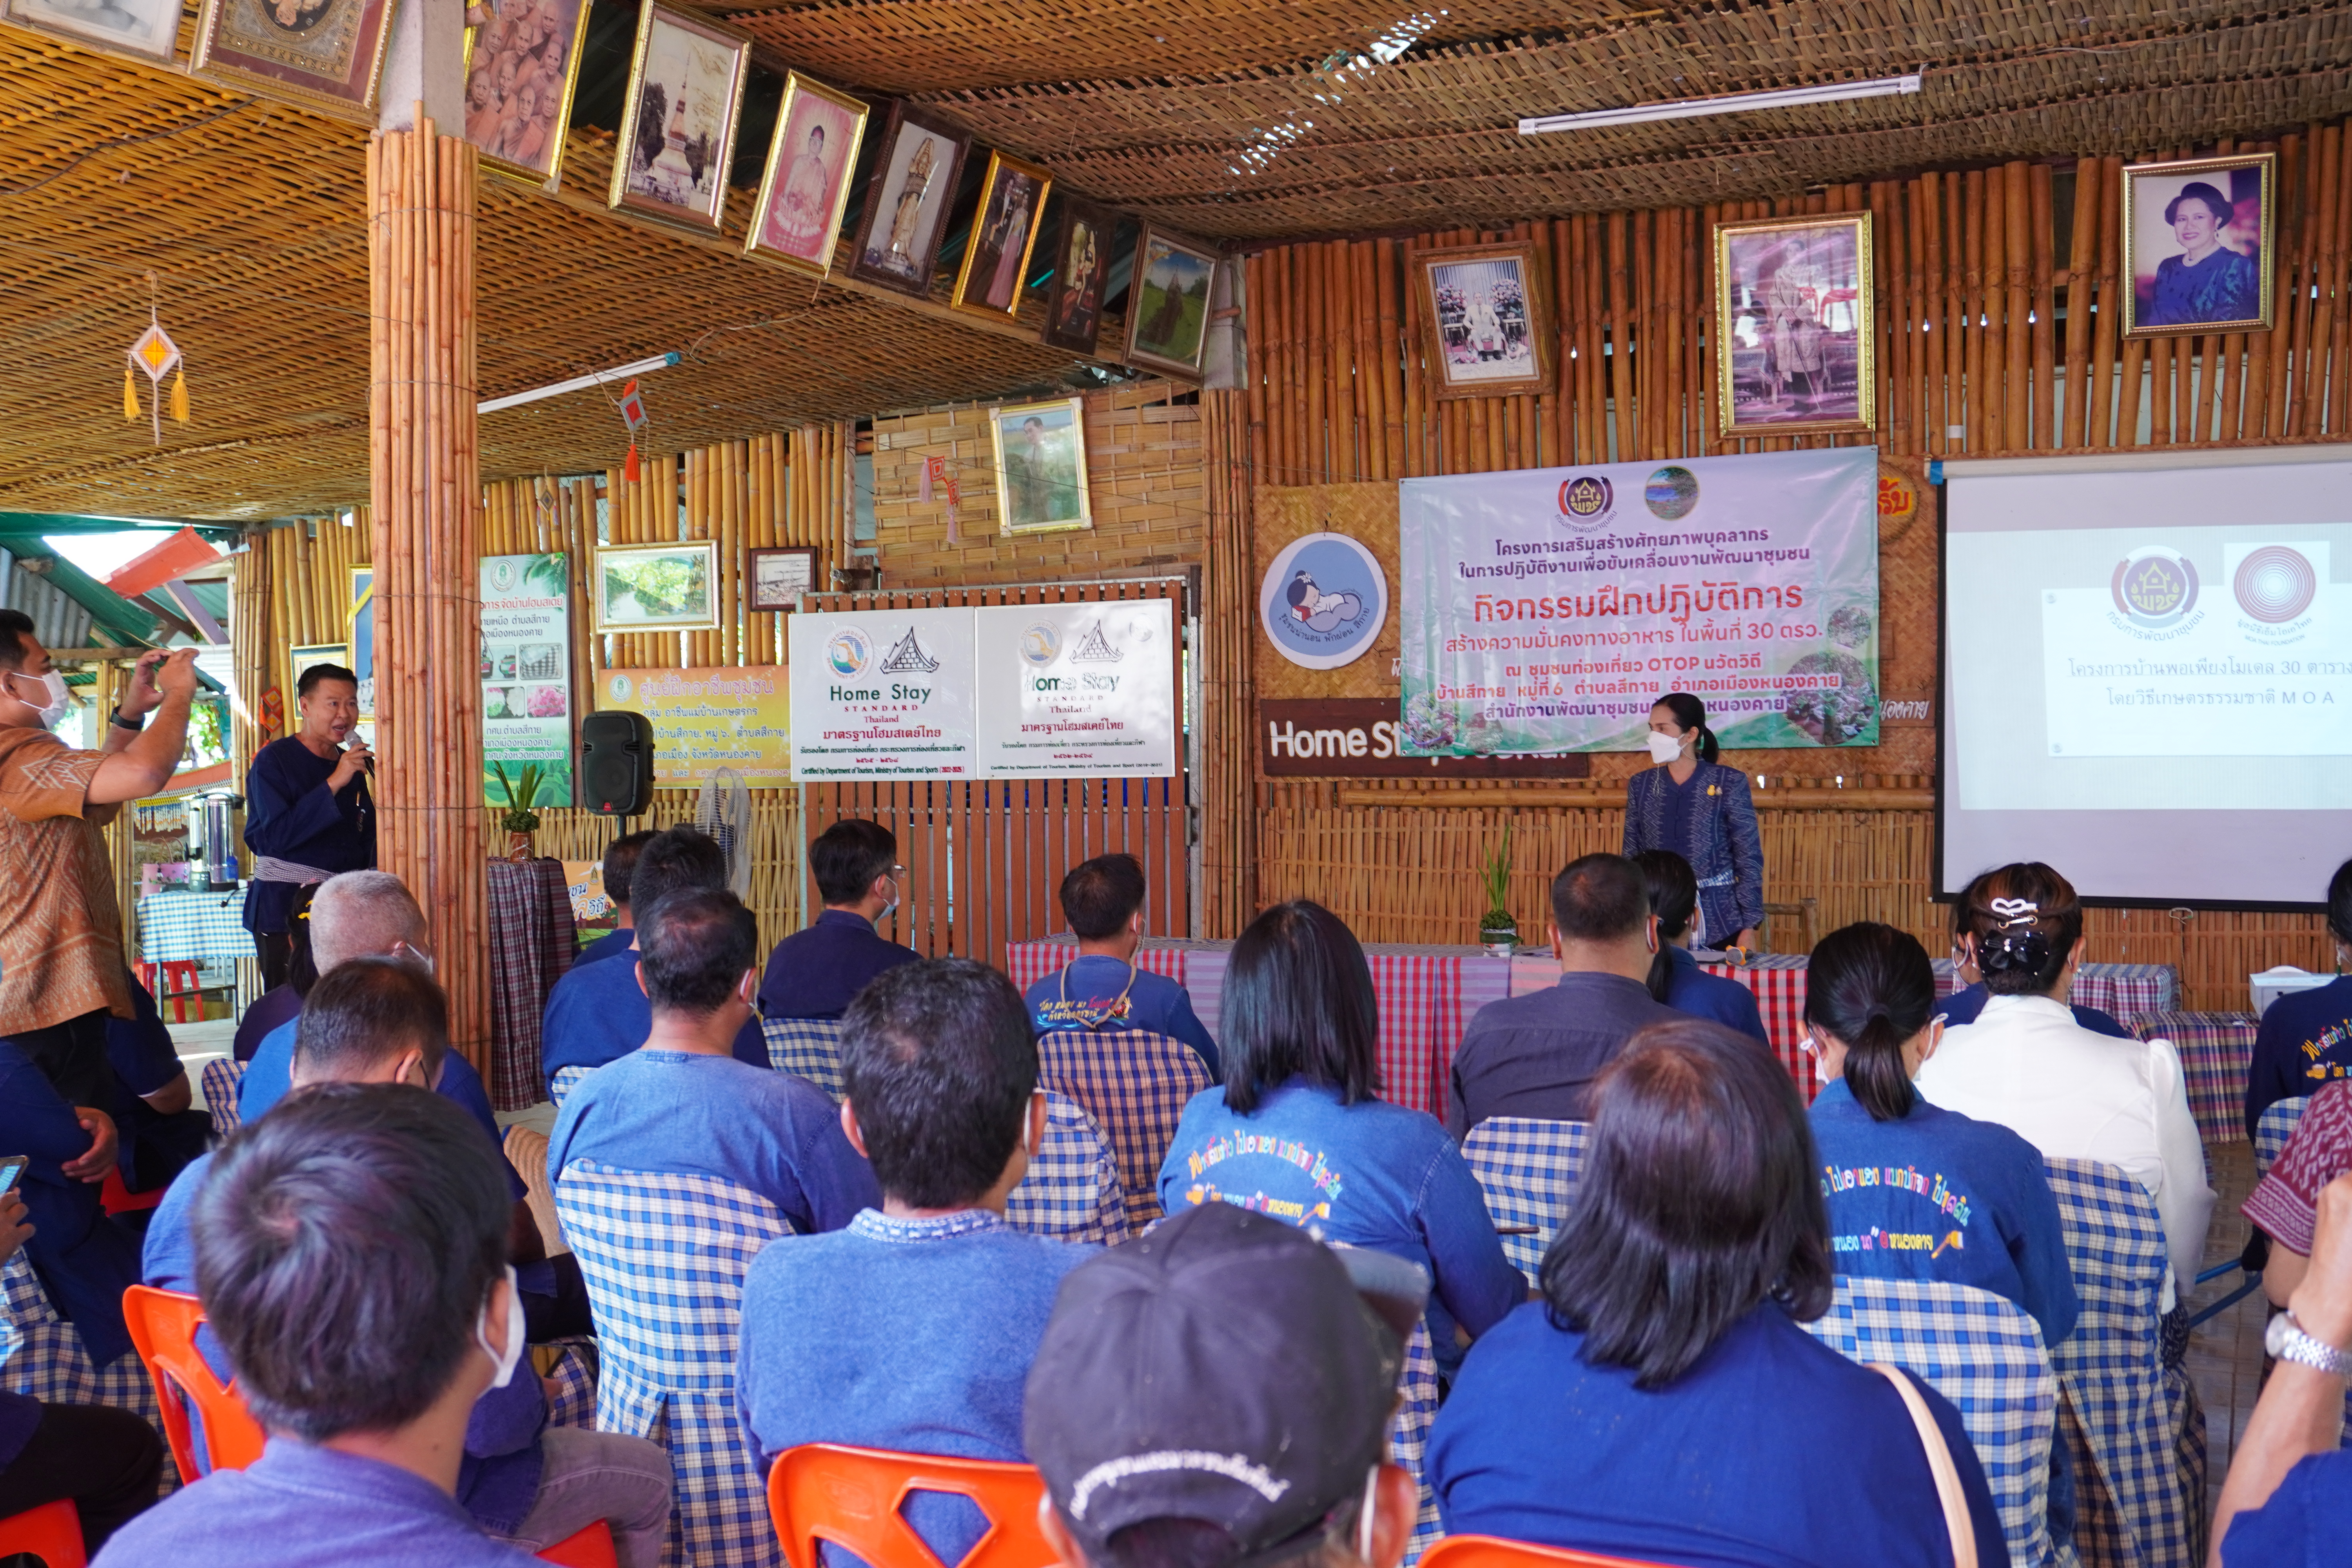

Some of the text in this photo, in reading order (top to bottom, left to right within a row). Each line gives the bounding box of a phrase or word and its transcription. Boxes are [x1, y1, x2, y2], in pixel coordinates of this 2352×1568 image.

[1555, 510, 1618, 534] กรมการพัฒนาชุมชน
[1495, 528, 1769, 556] โครงการเสริมสร้างศักยภาพบุคลากร
[1458, 548, 1810, 580] ในการปฏิบัติงานเพื่อขับเคลื่อนงานพัฒนาชุมชน
[1475, 580, 1803, 622] กิจกรรมฝึกปฏิบัติการ
[512, 614, 550, 624] ตำบลสีกาย
[2106, 610, 2205, 641] กรมการพัฒนาชุมชน
[1446, 616, 1823, 652] สร้างความมั่นคงทางอาหาร ในพื้นที่ 30 ตรว.
[1506, 652, 1761, 681] ณ ชุมชนท่องเที่ยว OTOP นวัตวิถี
[2069, 656, 2275, 677] โครงการบ้านพอเพียงโมเดล
[2281, 661, 2300, 675] 30
[639, 673, 774, 705] ศูนย์ฝึกอาชีพชุมชน
[1024, 671, 1120, 692] Home Stay
[1436, 674, 1839, 701] บ้านสีกาย หมู่ที่ 6 ตำบลสีกาย อำเภอเมืองหนองคาย
[830, 683, 931, 704] Home Stay
[2107, 687, 2275, 706] โดยวิธีเกษตรธรรมชาติ
[643, 704, 758, 722] กลุ่ม อาชีพแม่บ้านเกษตรกร
[864, 715, 899, 724] Thailand
[1049, 704, 1092, 714] Thailand
[705, 727, 719, 742] หมู่
[737, 725, 785, 738] ตำบลสีกาย
[823, 725, 942, 742] มาตรฐานโฮมสเตย์ไทย
[1021, 717, 1124, 735] มาตรฐานโฮมสเตย์ไทย
[1270, 720, 1367, 758] Home
[691, 746, 762, 759] จังหวัดหนองคาย
[820, 767, 825, 775] by
[826, 767, 851, 775] Department
[875, 766, 891, 775] Ministry
[925, 766, 938, 775] Sports
